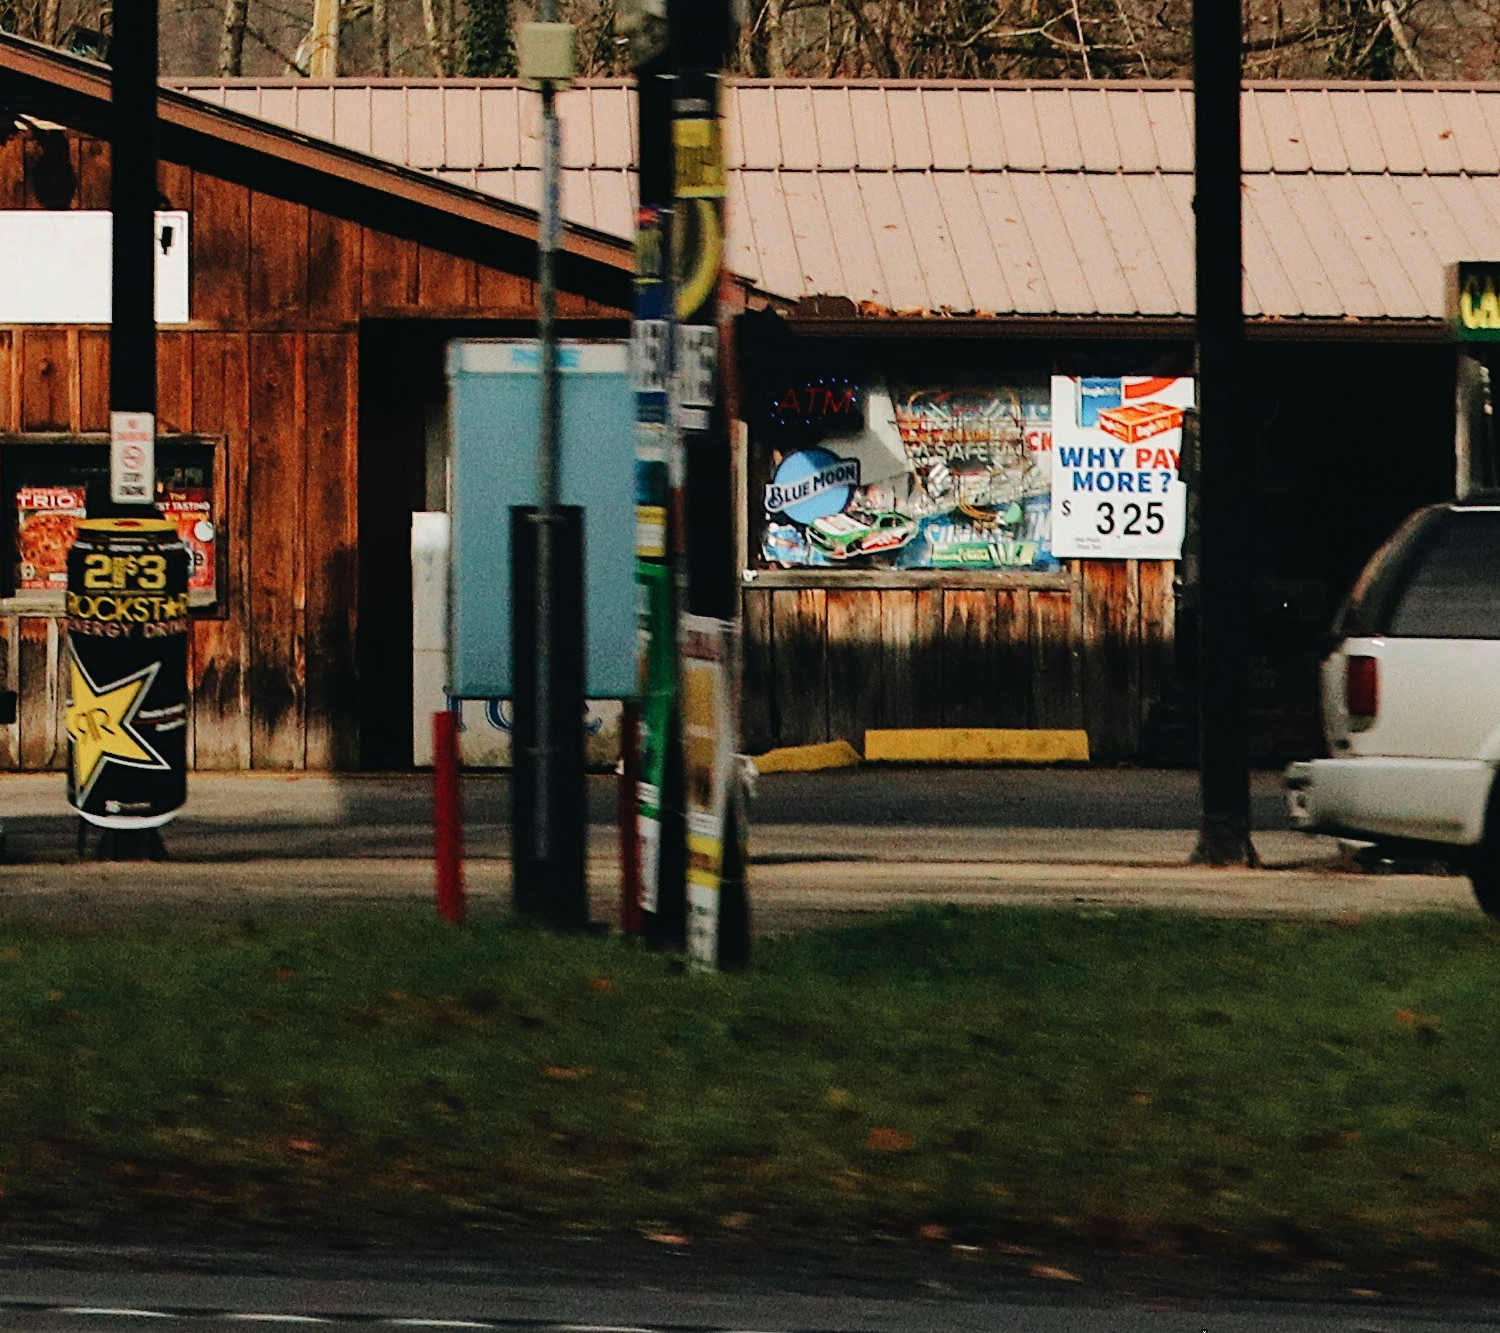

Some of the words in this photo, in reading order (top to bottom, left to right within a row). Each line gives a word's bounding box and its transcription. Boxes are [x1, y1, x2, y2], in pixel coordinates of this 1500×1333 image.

[777, 387, 853, 415] ATM
[1059, 446, 1126, 469] WHY
[1135, 448, 1181, 470] PAY
[767, 484, 811, 509] BLUE
[812, 463, 858, 491] MOON
[1072, 471, 1152, 493] MORE
[16, 492, 76, 509] TRIO
[83, 553, 112, 589] 2
[67, 616, 133, 639] NERGY
